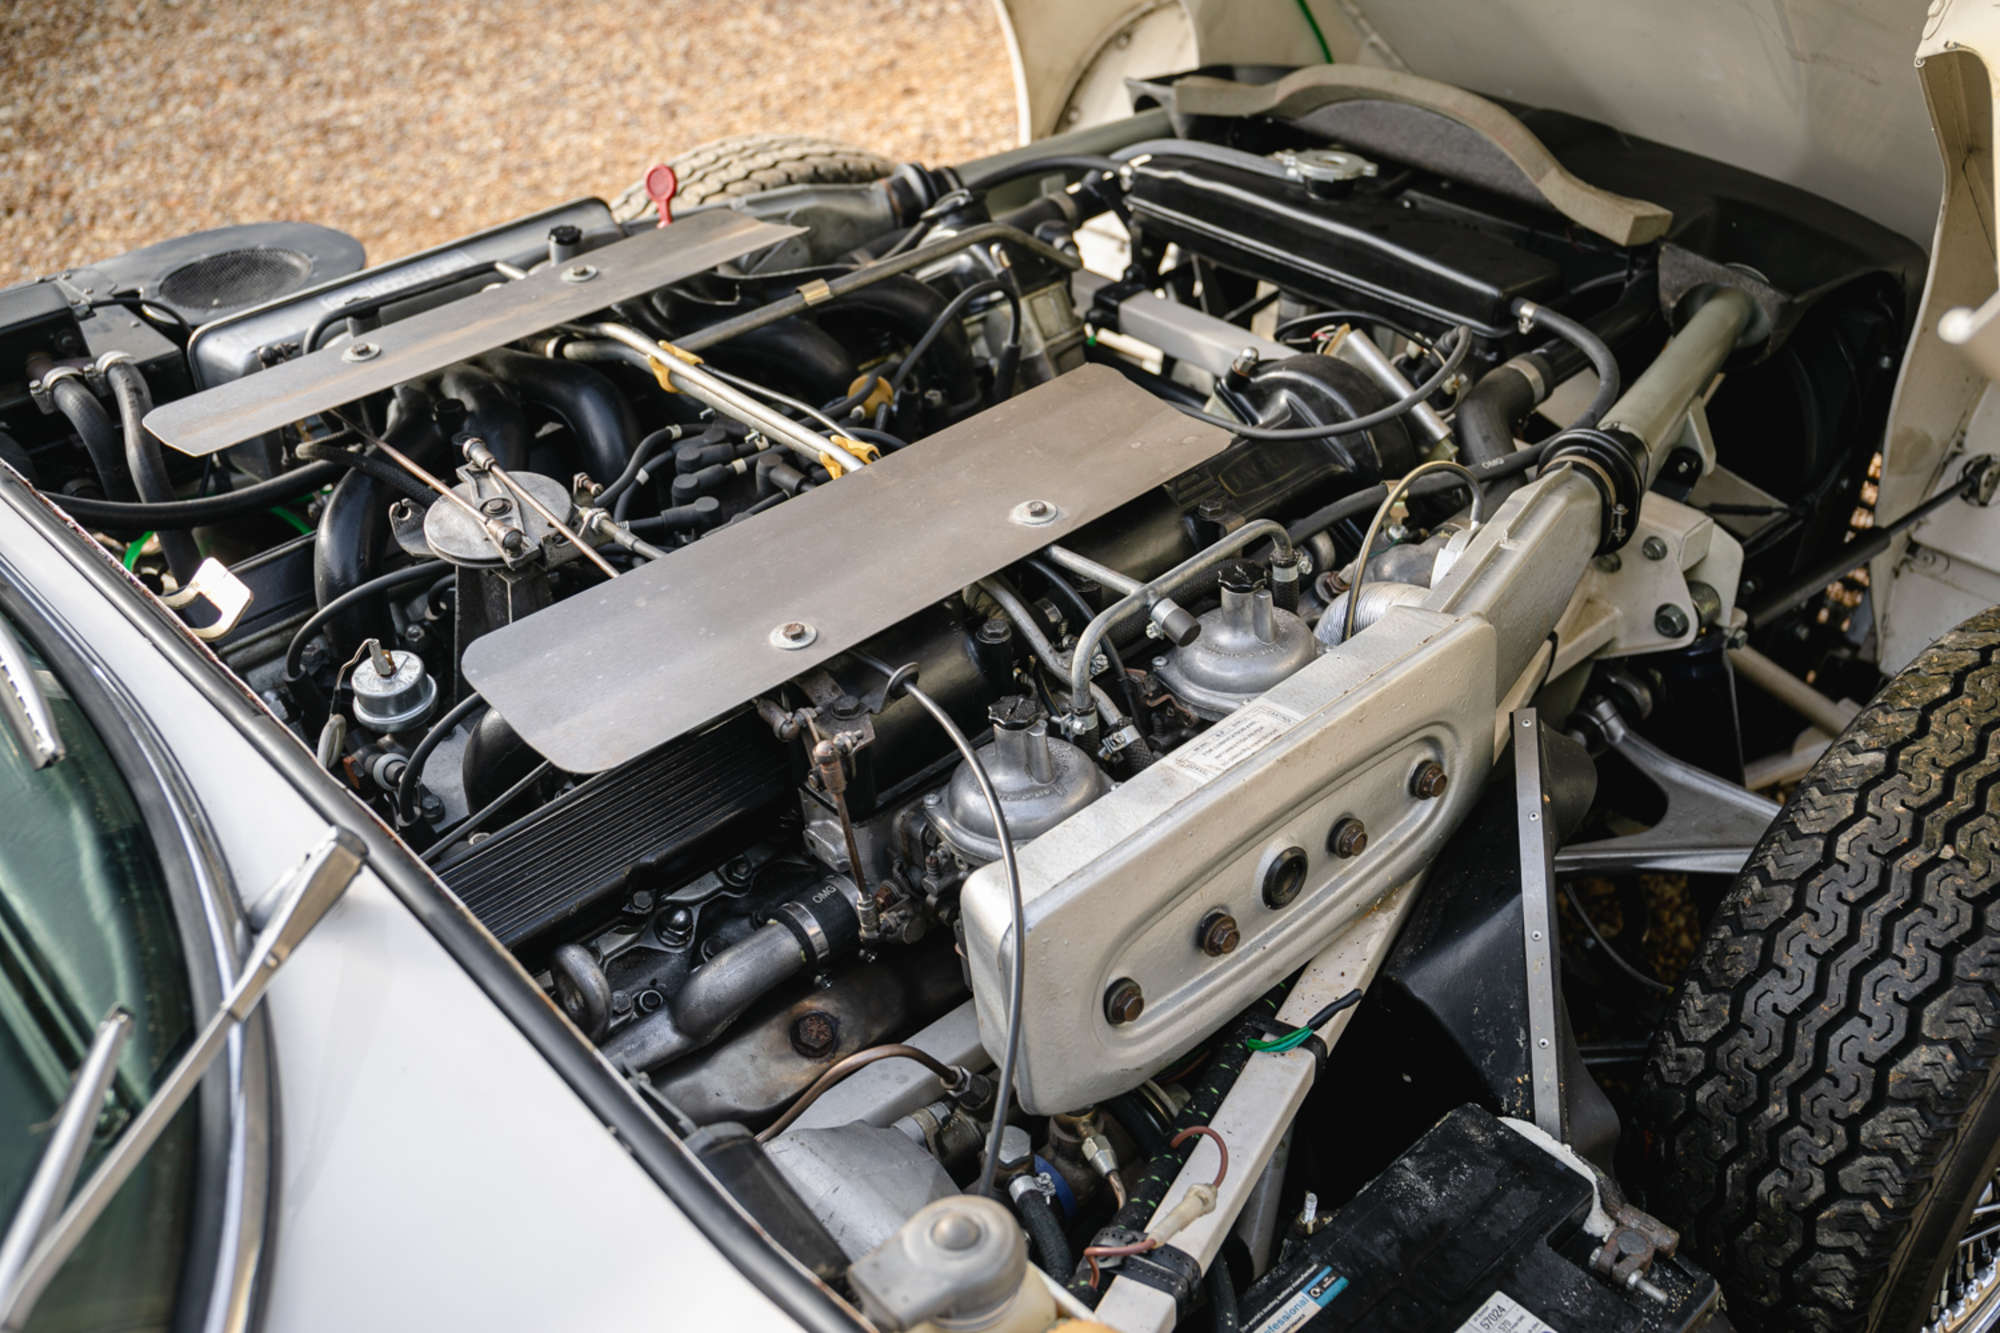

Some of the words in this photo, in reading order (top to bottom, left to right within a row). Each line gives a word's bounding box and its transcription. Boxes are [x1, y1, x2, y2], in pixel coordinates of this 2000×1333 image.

[1481, 457, 1504, 469] OMG
[812, 885, 837, 904] OMG
[1479, 1304, 1506, 1330] 57024
